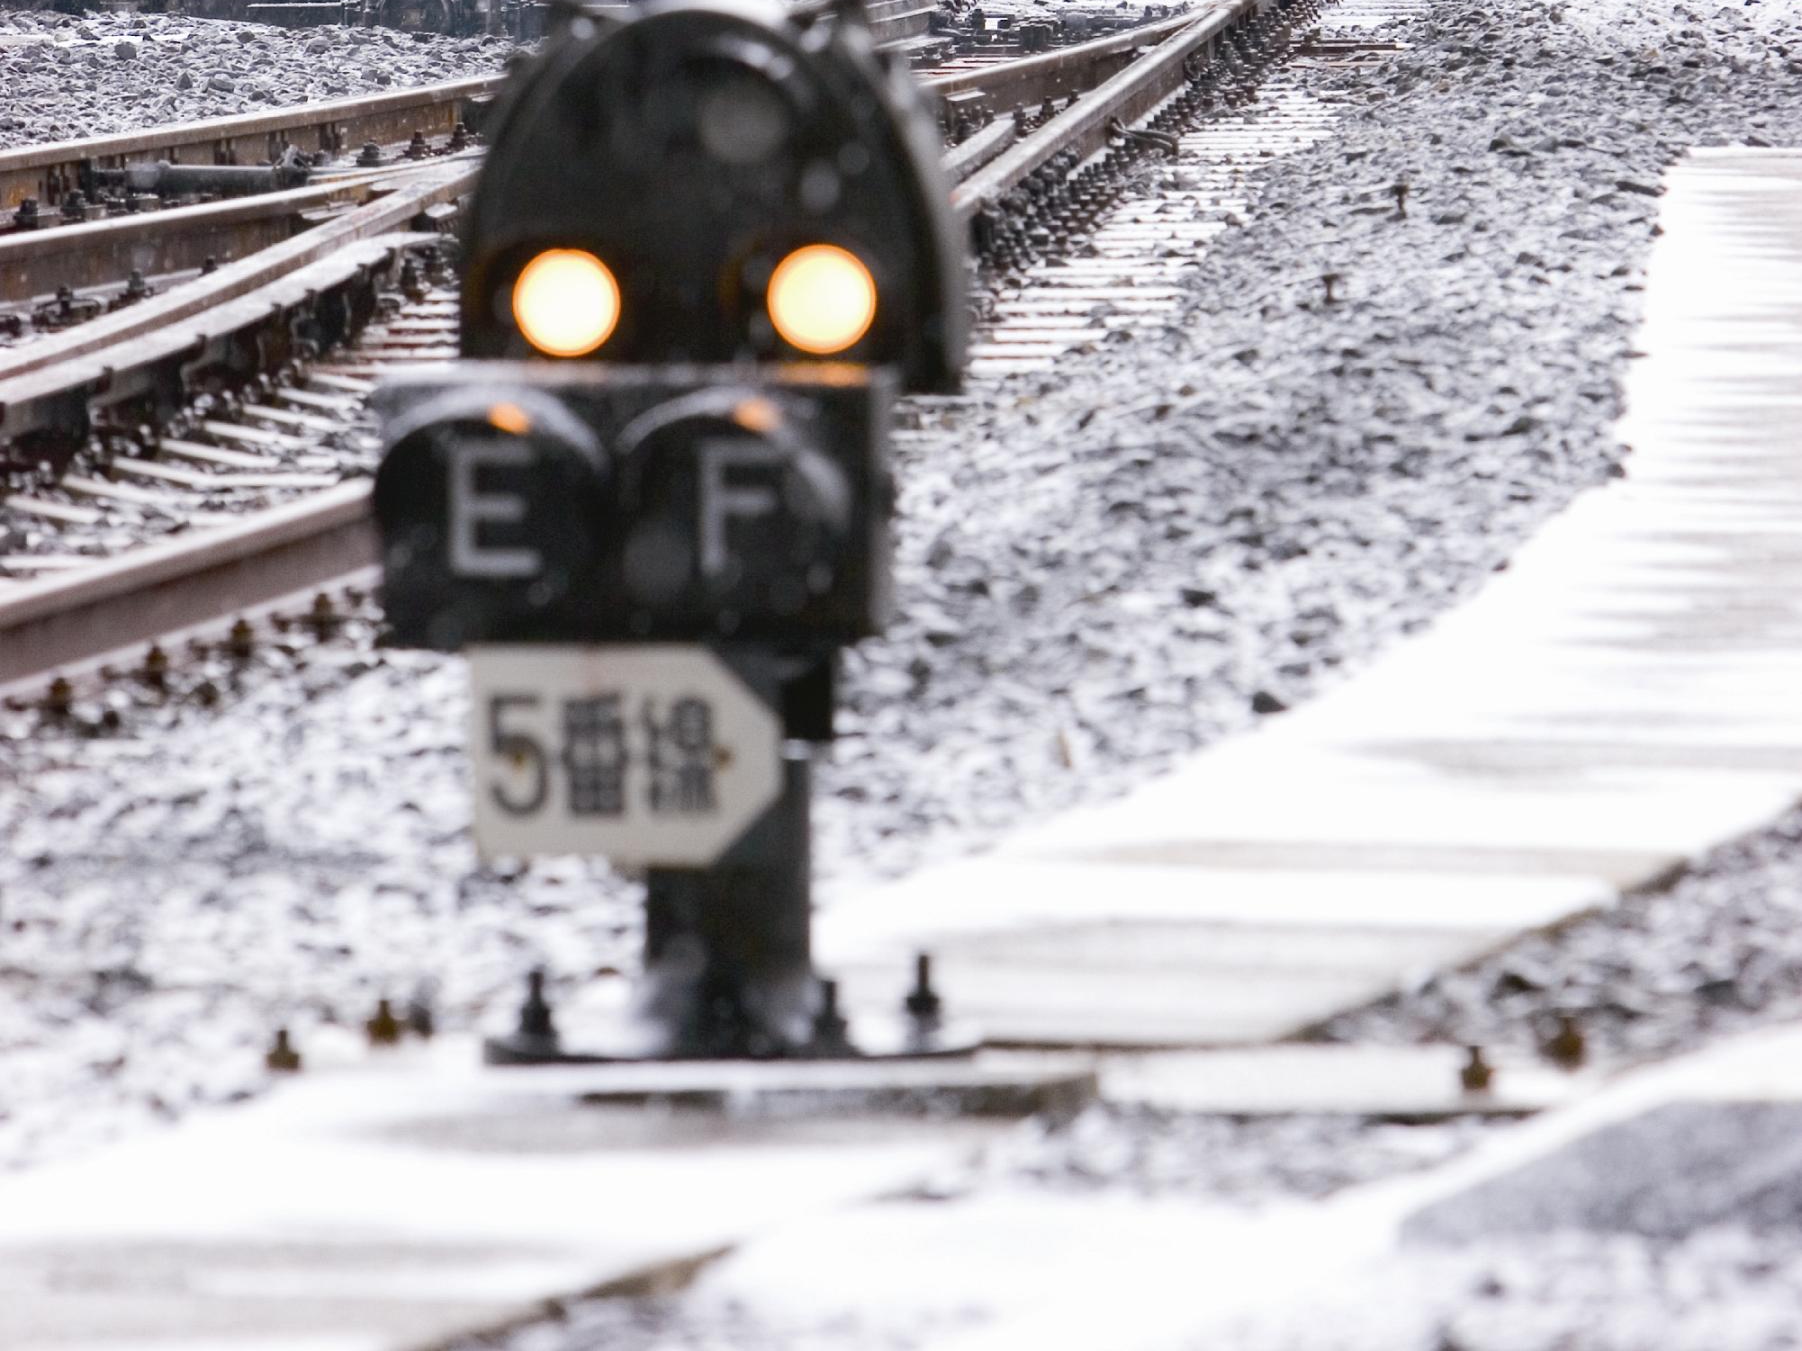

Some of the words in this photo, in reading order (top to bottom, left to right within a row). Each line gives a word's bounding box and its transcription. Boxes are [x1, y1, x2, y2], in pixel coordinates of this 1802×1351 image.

[449, 442, 541, 578] E
[700, 442, 787, 577] F
[488, 690, 718, 818] 5番線
